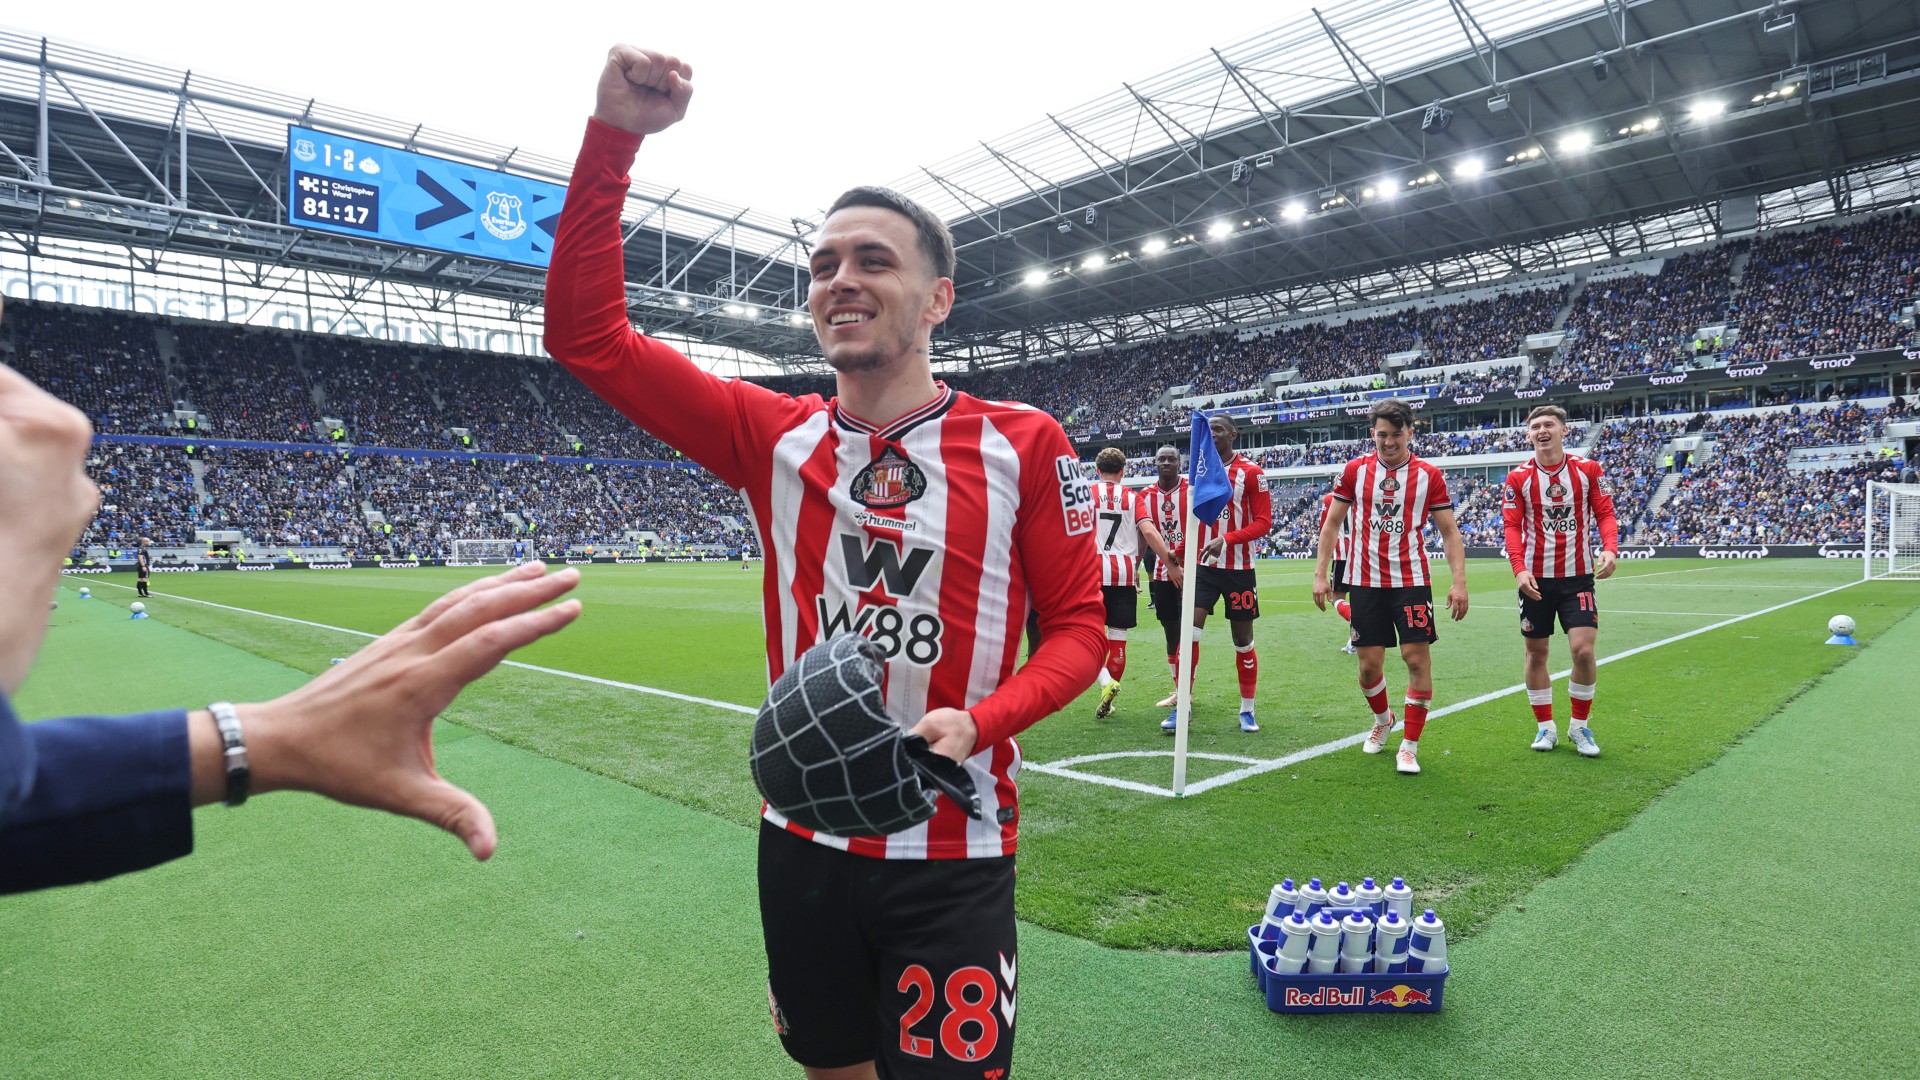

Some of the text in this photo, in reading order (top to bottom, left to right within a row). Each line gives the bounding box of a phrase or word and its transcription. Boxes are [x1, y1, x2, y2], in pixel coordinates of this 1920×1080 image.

[332, 182, 374, 197] Christopher
[332, 189, 352, 199] Ward
[303, 197, 369, 224] 81:17
[492, 216, 516, 227] Everton
[1410, 401, 1425, 409] oro
[1057, 458, 1080, 482] Liv
[1375, 503, 1400, 516] W
[1545, 507, 1571, 520] W
[868, 514, 916, 531] hummel
[1100, 512, 1122, 551] 7
[1370, 519, 1404, 533] W88
[1543, 519, 1577, 532] W88
[840, 534, 935, 597] W
[1229, 591, 1253, 610] 20
[1576, 592, 1594, 612] 11
[1404, 605, 1428, 628] 13
[819, 597, 940, 665] W88
[1285, 987, 1364, 1006] Red Bull
[897, 964, 999, 1062] 28
